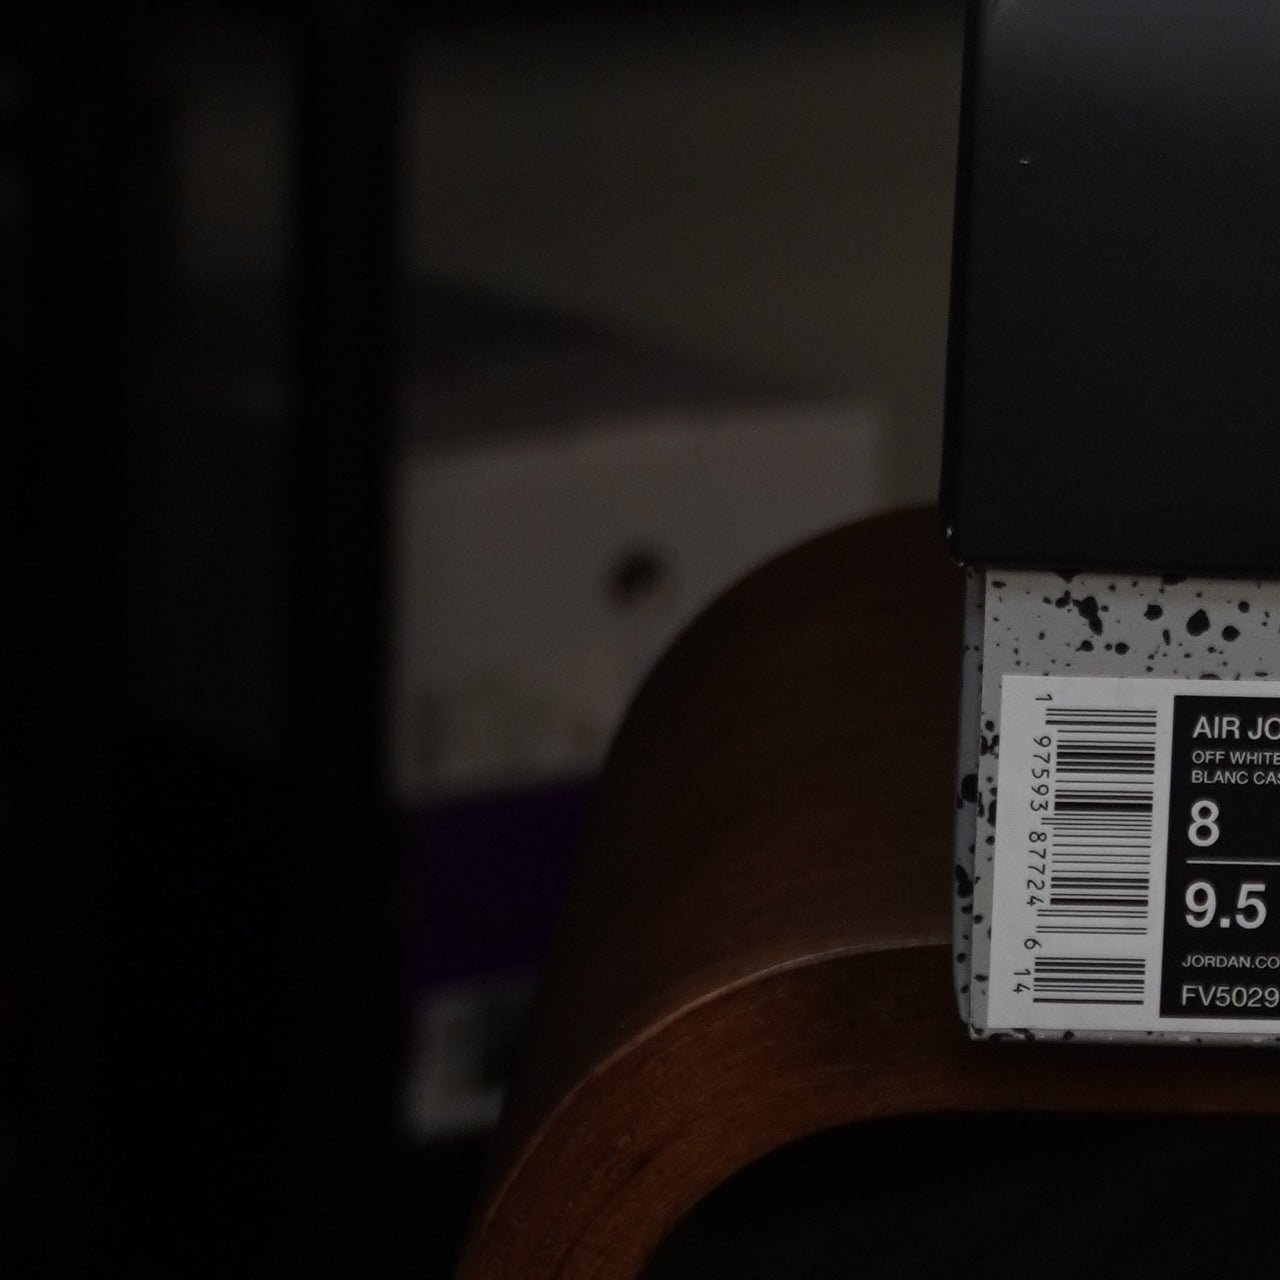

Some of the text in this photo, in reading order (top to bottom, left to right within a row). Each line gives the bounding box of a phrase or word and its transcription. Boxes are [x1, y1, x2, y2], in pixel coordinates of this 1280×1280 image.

[1192, 716, 1240, 739] AIR
[1191, 750, 1226, 765] OFF
[1030, 736, 1052, 812] 97593
[1191, 771, 1249, 785] BLANC
[1188, 800, 1220, 847] 8
[1026, 831, 1048, 907] 87724
[1185, 882, 1267, 929] 9.5
[1024, 938, 1042, 950] 6
[1013, 968, 1032, 994] 14
[1181, 985, 1280, 1008] FV5029
